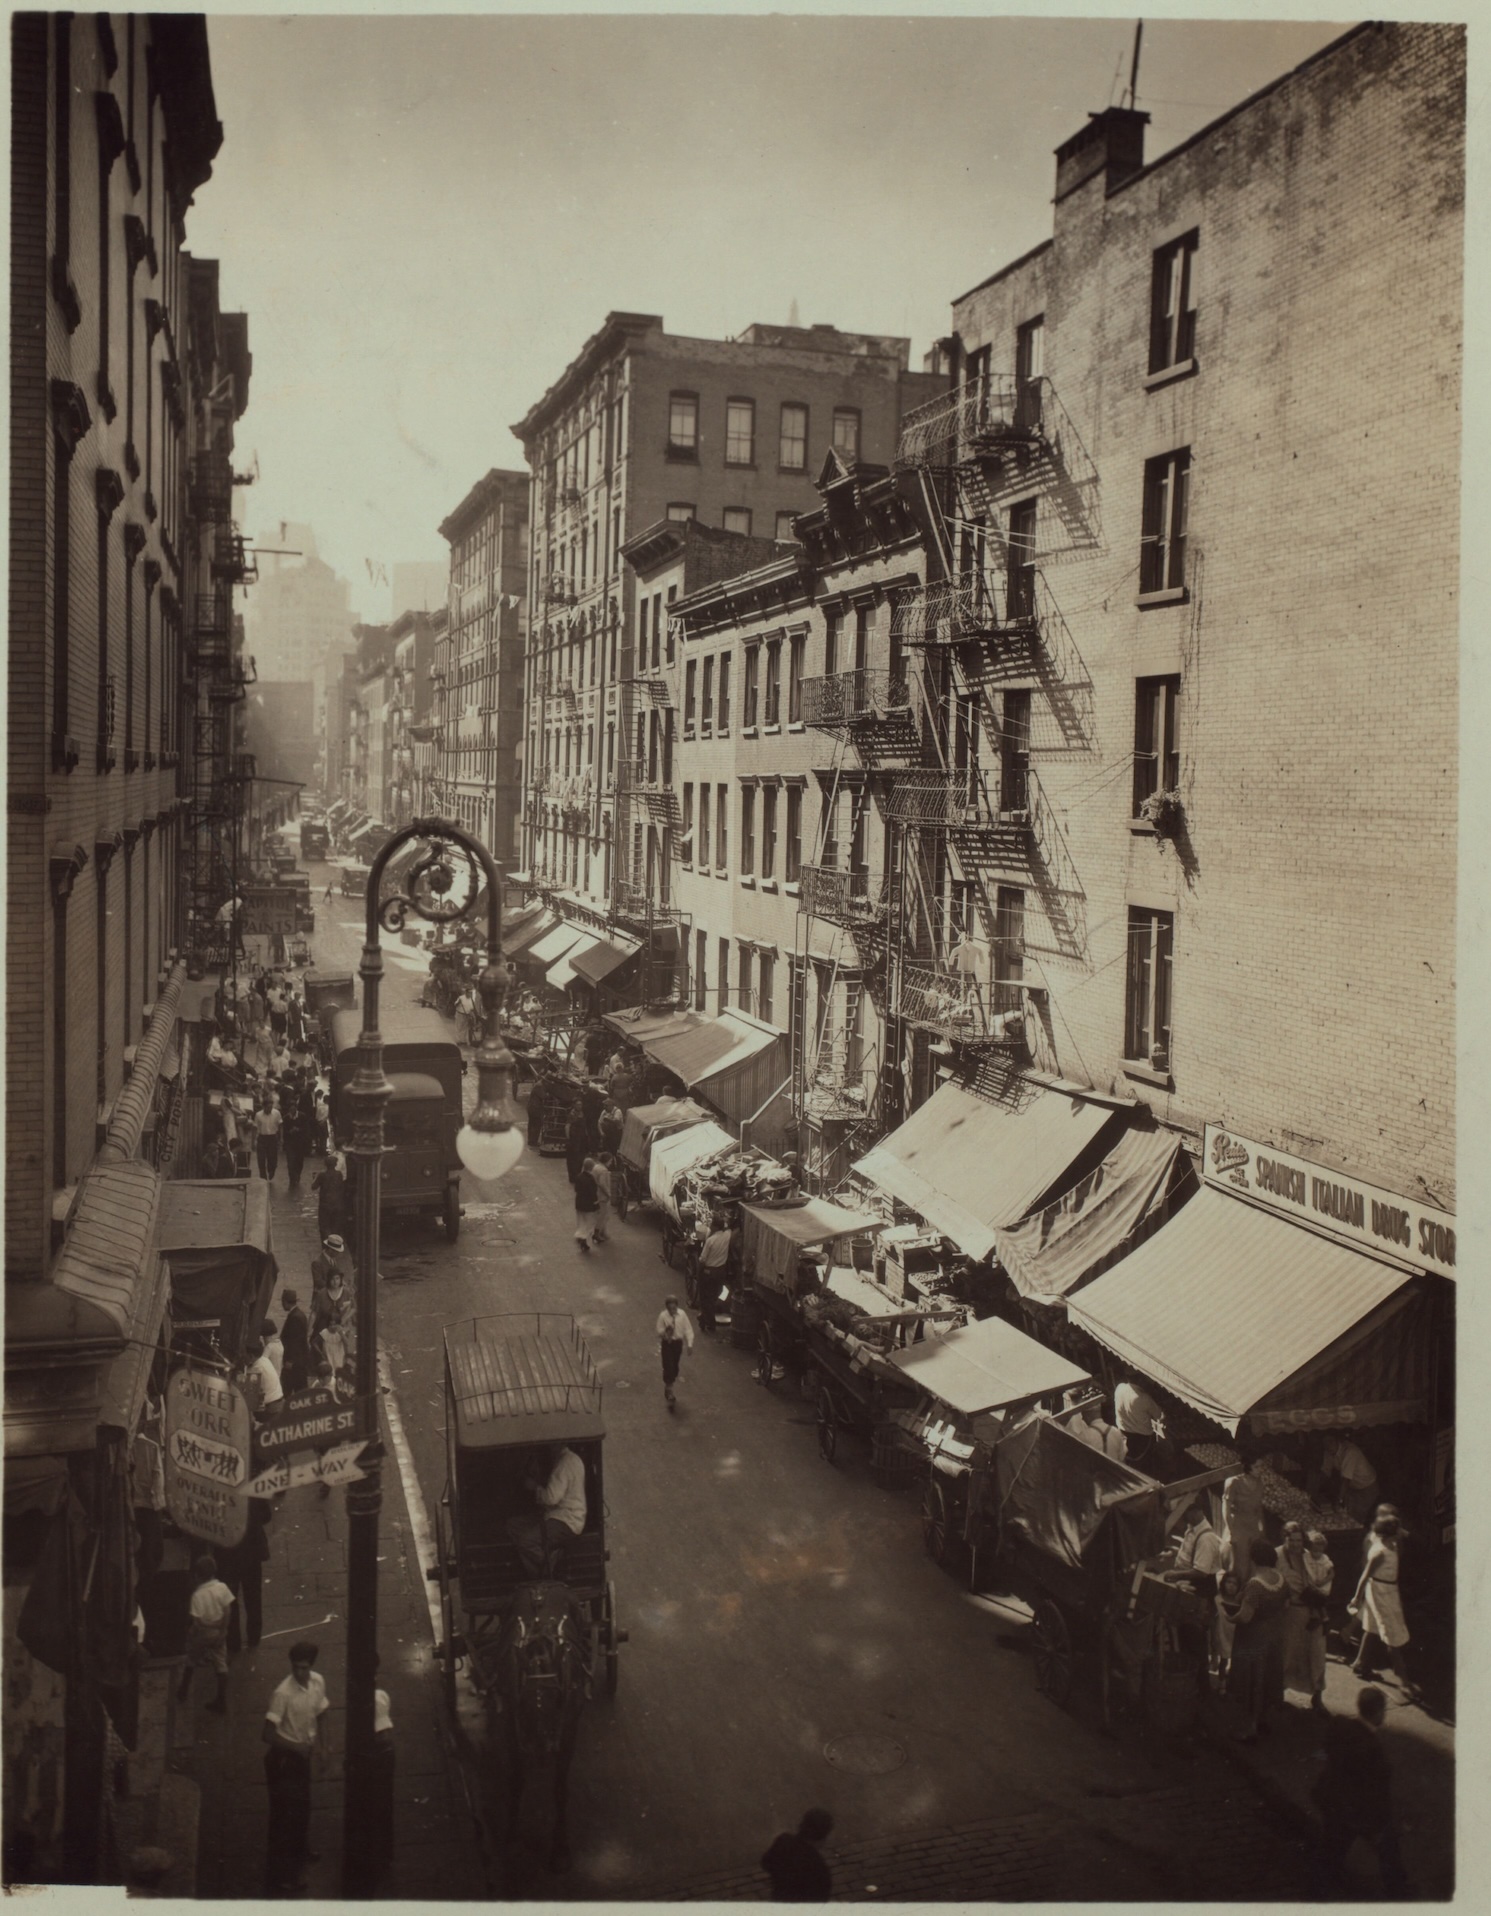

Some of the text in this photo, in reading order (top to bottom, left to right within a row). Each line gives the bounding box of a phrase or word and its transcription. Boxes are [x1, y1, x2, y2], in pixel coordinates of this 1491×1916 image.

[243, 897, 292, 912] APITOL
[241, 919, 292, 933] PAINTS
[160, 1134, 176, 1163] CITY
[1255, 1155, 1306, 1207] SPANISH
[1312, 1176, 1364, 1230] ITALIAN
[1371, 1198, 1411, 1249] DRUG
[180, 1378, 238, 1413] SWEET
[289, 1397, 313, 1410] OAK
[191, 1407, 232, 1438] ORR
[260, 1416, 334, 1447] CATHARINE
[1266, 1404, 1358, 1430] EGGS
[254, 1473, 290, 1495] ONE
[311, 1457, 348, 1476] WAY
[177, 1477, 236, 1507] OVERALLS
